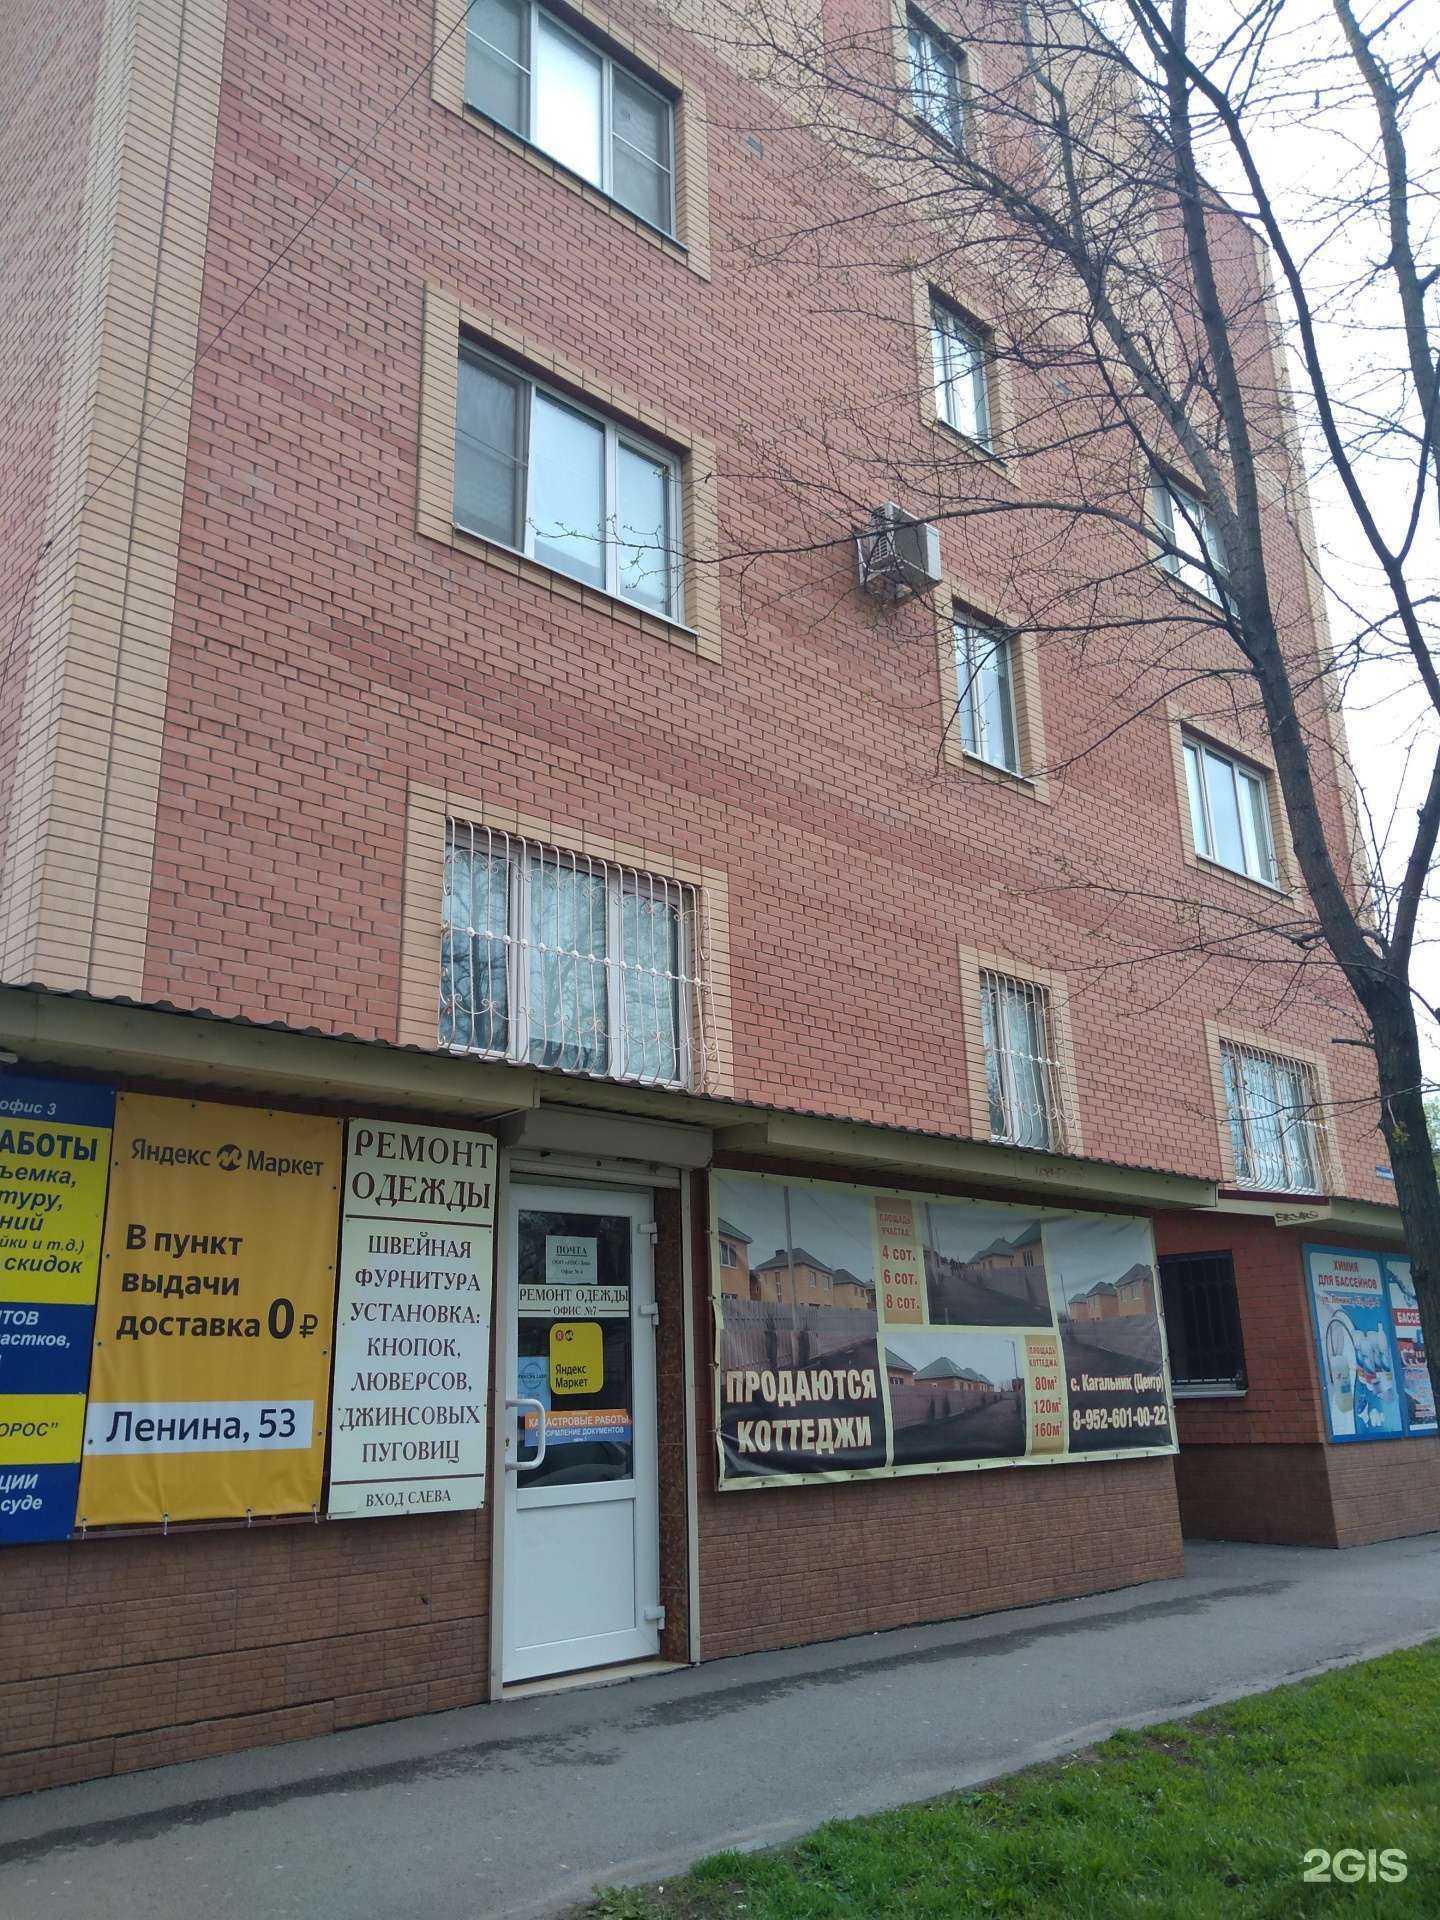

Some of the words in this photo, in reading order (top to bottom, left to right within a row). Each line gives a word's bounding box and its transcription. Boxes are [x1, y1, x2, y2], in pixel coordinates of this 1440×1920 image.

[47, 1102, 57, 1116] 3
[131, 1138, 212, 1167] Яндекс
[247, 1149, 324, 1178] Маркет
[354, 1129, 494, 1168] РЕМОНТ
[352, 1171, 491, 1211] ОДЕЖДЫ
[33, 1239, 42, 1250] и
[126, 1224, 147, 1250] В
[154, 1231, 243, 1259] пункт
[368, 1231, 471, 1258] ШВЕЙНАЯ
[556, 1245, 587, 1255] ПОЧТА
[882, 1245, 889, 1260] 4
[4, 1255, 83, 1274] скидок
[122, 1271, 240, 1298] выдачи
[354, 1269, 481, 1292] ФУРНИТУРА
[883, 1269, 891, 1285] 6
[1318, 1274, 1334, 1288] ДЛЯ
[520, 1288, 572, 1301] РЕМОНТ
[576, 1289, 628, 1303] ОДЕЖДЫ
[886, 1294, 893, 1309] 8
[0, 1310, 39, 1326] ТОВ
[116, 1313, 260, 1340] доставка
[267, 1298, 294, 1339] 0
[350, 1302, 481, 1325] УСТАНОВКА:
[553, 1306, 581, 1316] ОФИС
[367, 1336, 461, 1359] КНОПОК,
[555, 1364, 587, 1375] Яндекс
[350, 1370, 472, 1392] ЛЮВЕРСОВ,
[555, 1377, 588, 1389] Маркет
[726, 1369, 877, 1407] ПРОДАЮТСЯ
[1081, 1374, 1133, 1392] Кагальник
[1134, 1373, 1164, 1394] (Центр)
[106, 1410, 250, 1444] Ленина,
[258, 1409, 296, 1439] 53
[339, 1405, 480, 1431] ДЖИНСОВЫХ
[529, 1415, 593, 1427] КААСТРОВЫЕ
[1072, 1405, 1168, 1431] 8-952-601-00-22
[536, 1427, 581, 1437] ОРМЛЕНИЕ
[737, 1417, 872, 1455] КОТТЕДЖИ
[362, 1440, 460, 1465] ПУГОВИЦ
[0, 1494, 43, 1515] суде
[365, 1492, 403, 1507] ВХОД
[408, 1489, 451, 1505] СЛЕВА
